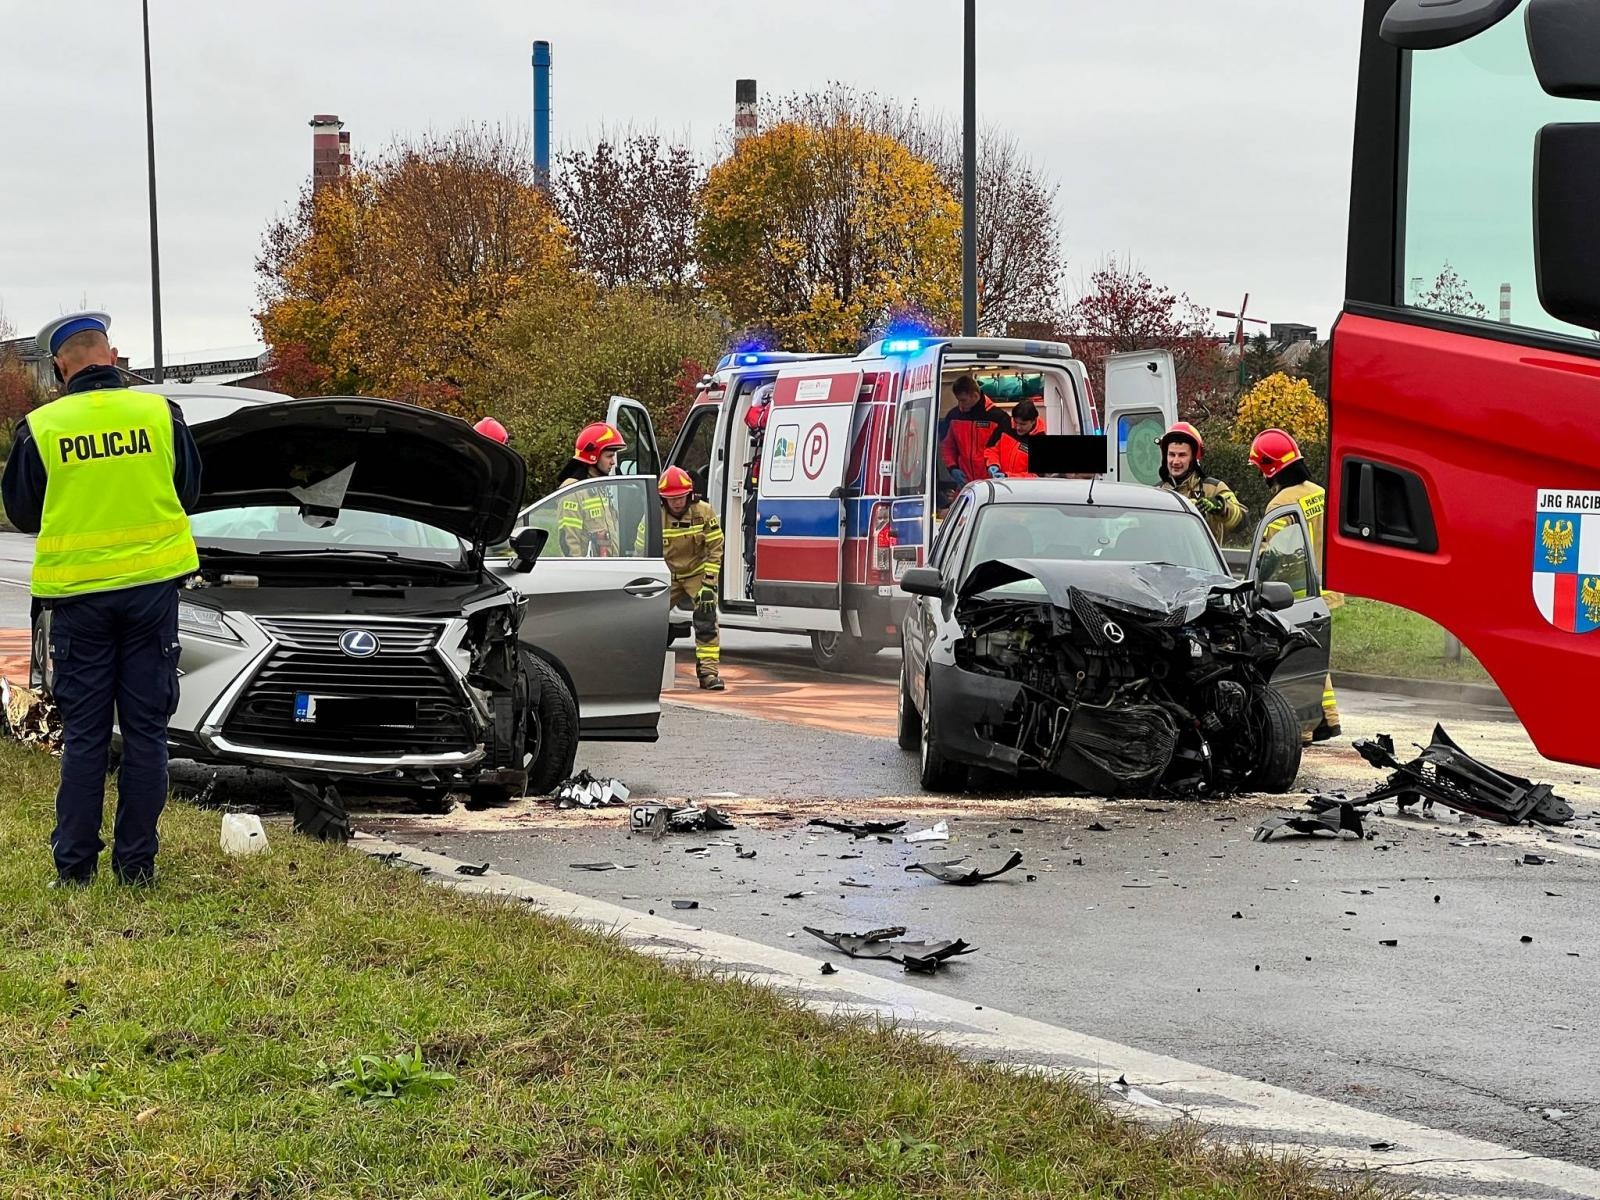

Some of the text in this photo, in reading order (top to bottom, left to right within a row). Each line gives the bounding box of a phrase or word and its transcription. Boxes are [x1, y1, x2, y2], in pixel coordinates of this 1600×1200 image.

[59, 428, 152, 463] POLICJA
[1540, 494, 1600, 509] JRG RACIB
[296, 708, 307, 716] CZ
[633, 808, 656, 828] 45
